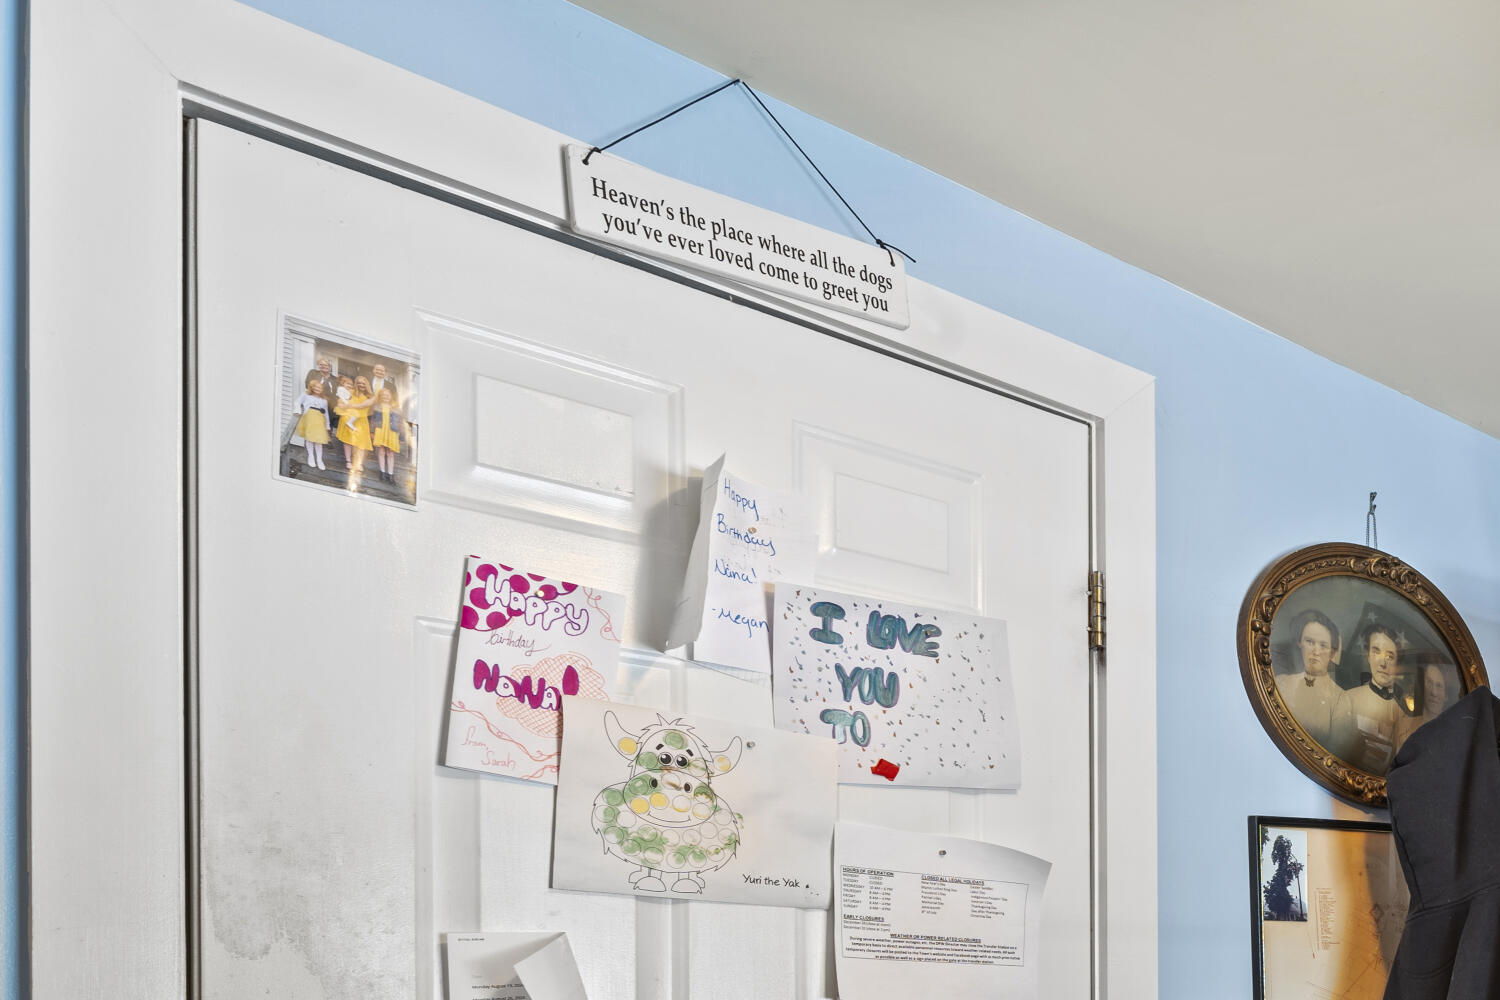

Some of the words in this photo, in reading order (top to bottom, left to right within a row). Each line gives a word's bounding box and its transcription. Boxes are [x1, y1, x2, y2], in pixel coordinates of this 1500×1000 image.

[591, 177, 675, 220] Heaven's
[680, 206, 706, 231] the
[711, 218, 753, 246] place
[758, 231, 805, 263] where
[810, 245, 828, 270] all
[832, 255, 855, 279] the
[859, 266, 893, 293] dogs
[602, 213, 663, 243] you've
[668, 232, 704, 256] ever
[708, 240, 754, 271] loved
[759, 260, 799, 284] come
[803, 270, 818, 292] to
[822, 278, 859, 303] greet
[862, 290, 889, 312] you
[724, 478, 759, 521] Happy
[717, 513, 776, 556] Birthday
[809, 601, 846, 645] I
[866, 610, 942, 658] LOVE
[834, 663, 900, 708] YOU
[819, 708, 871, 747] TO
[742, 873, 762, 885] Yuri
[764, 877, 780, 886] the
[783, 878, 800, 888] Yak
